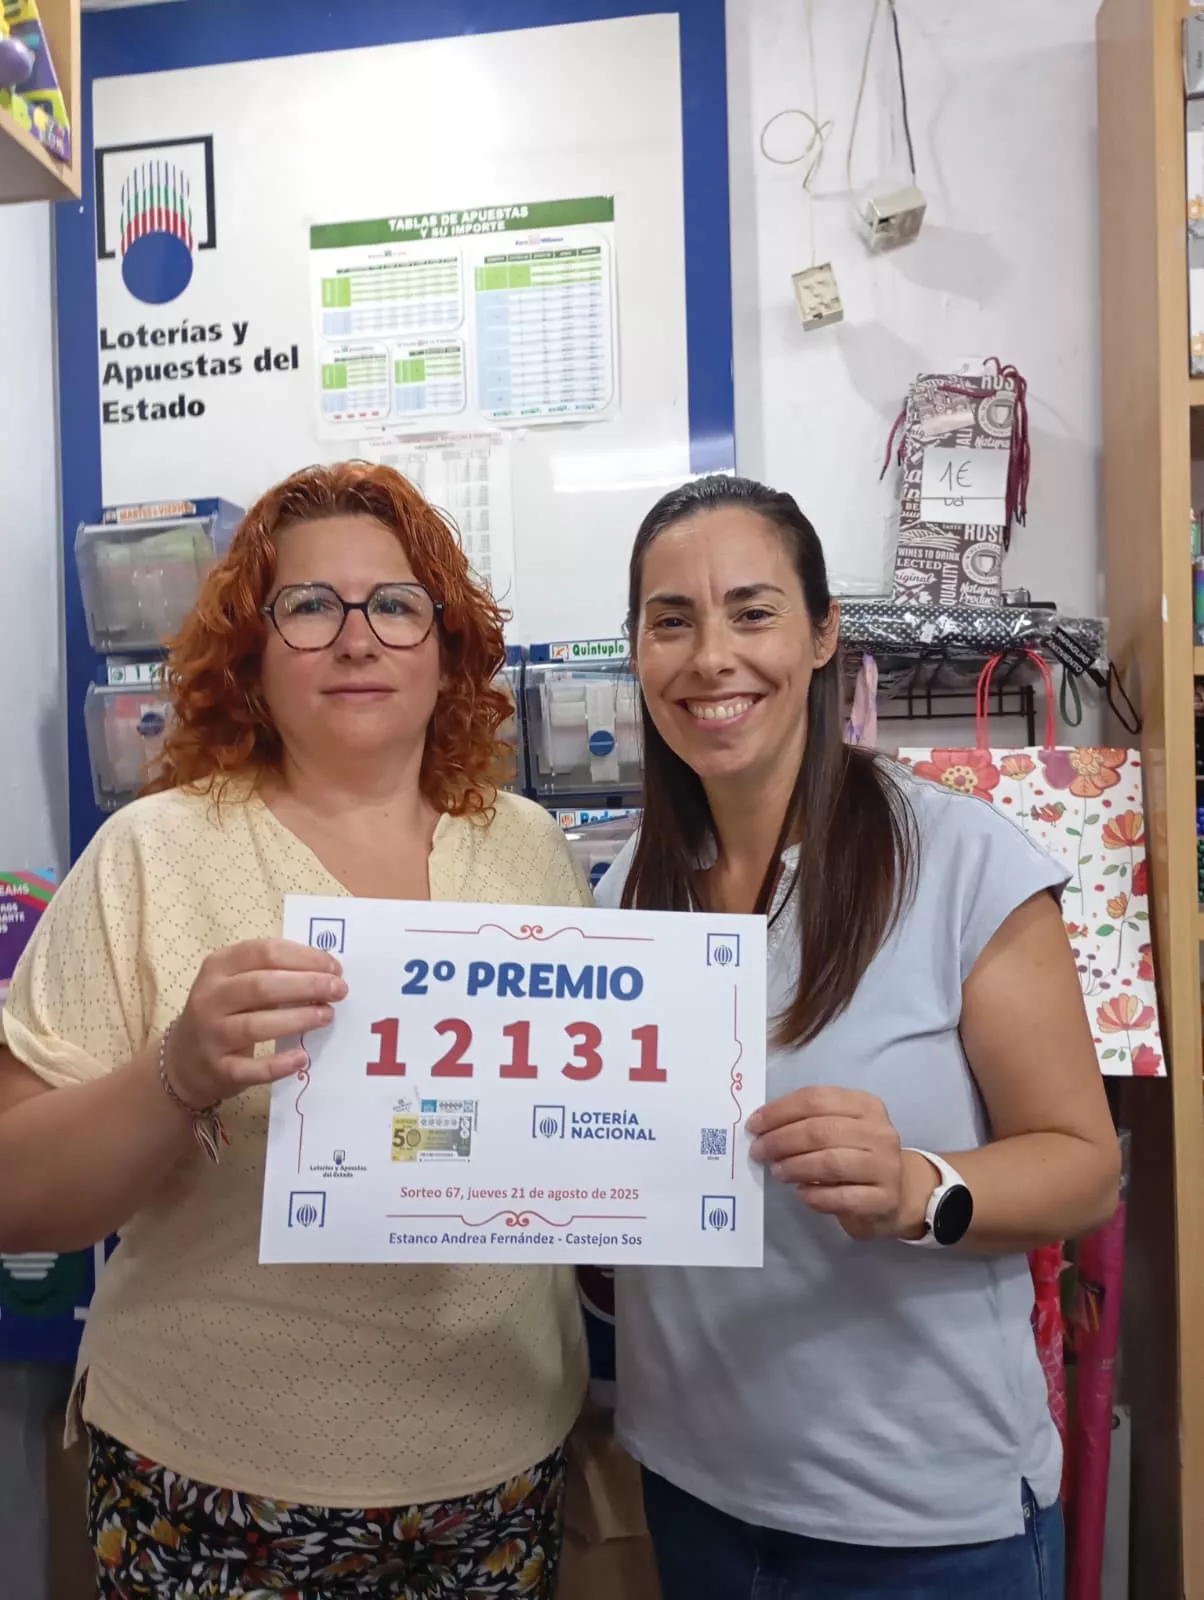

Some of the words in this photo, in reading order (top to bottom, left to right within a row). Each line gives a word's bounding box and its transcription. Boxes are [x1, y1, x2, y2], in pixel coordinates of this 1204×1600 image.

[388, 215, 438, 232] TABLAS
[441, 211, 459, 225] DE
[461, 206, 529, 223] APUESTAS
[451, 221, 506, 236] IMPORTE
[100, 320, 223, 351] Loterías
[232, 321, 249, 346] y
[102, 352, 243, 389] Apuestas
[253, 345, 299, 373] del
[102, 394, 206, 424] Estado
[940, 562, 958, 605] QUALITY
[401, 959, 455, 995] 2º
[467, 962, 644, 1001] PREMIO
[572, 1109, 639, 1125] LOTERÍA
[571, 1125, 656, 1141] NACIONAL
[400, 1187, 443, 1200] Sorteo
[445, 1187, 464, 1202] 67,
[467, 1187, 508, 1203] jueves
[511, 1188, 526, 1200] 21
[529, 1187, 545, 1201] de
[548, 1189, 589, 1204] agosto
[592, 1188, 607, 1201] de
[610, 1188, 640, 1201] 2025
[389, 1232, 438, 1246] Estanco
[441, 1232, 487, 1246] Andrea
[491, 1231, 554, 1246] Fernández
[566, 1232, 618, 1249] Castejon
[621, 1233, 643, 1247] Sos
